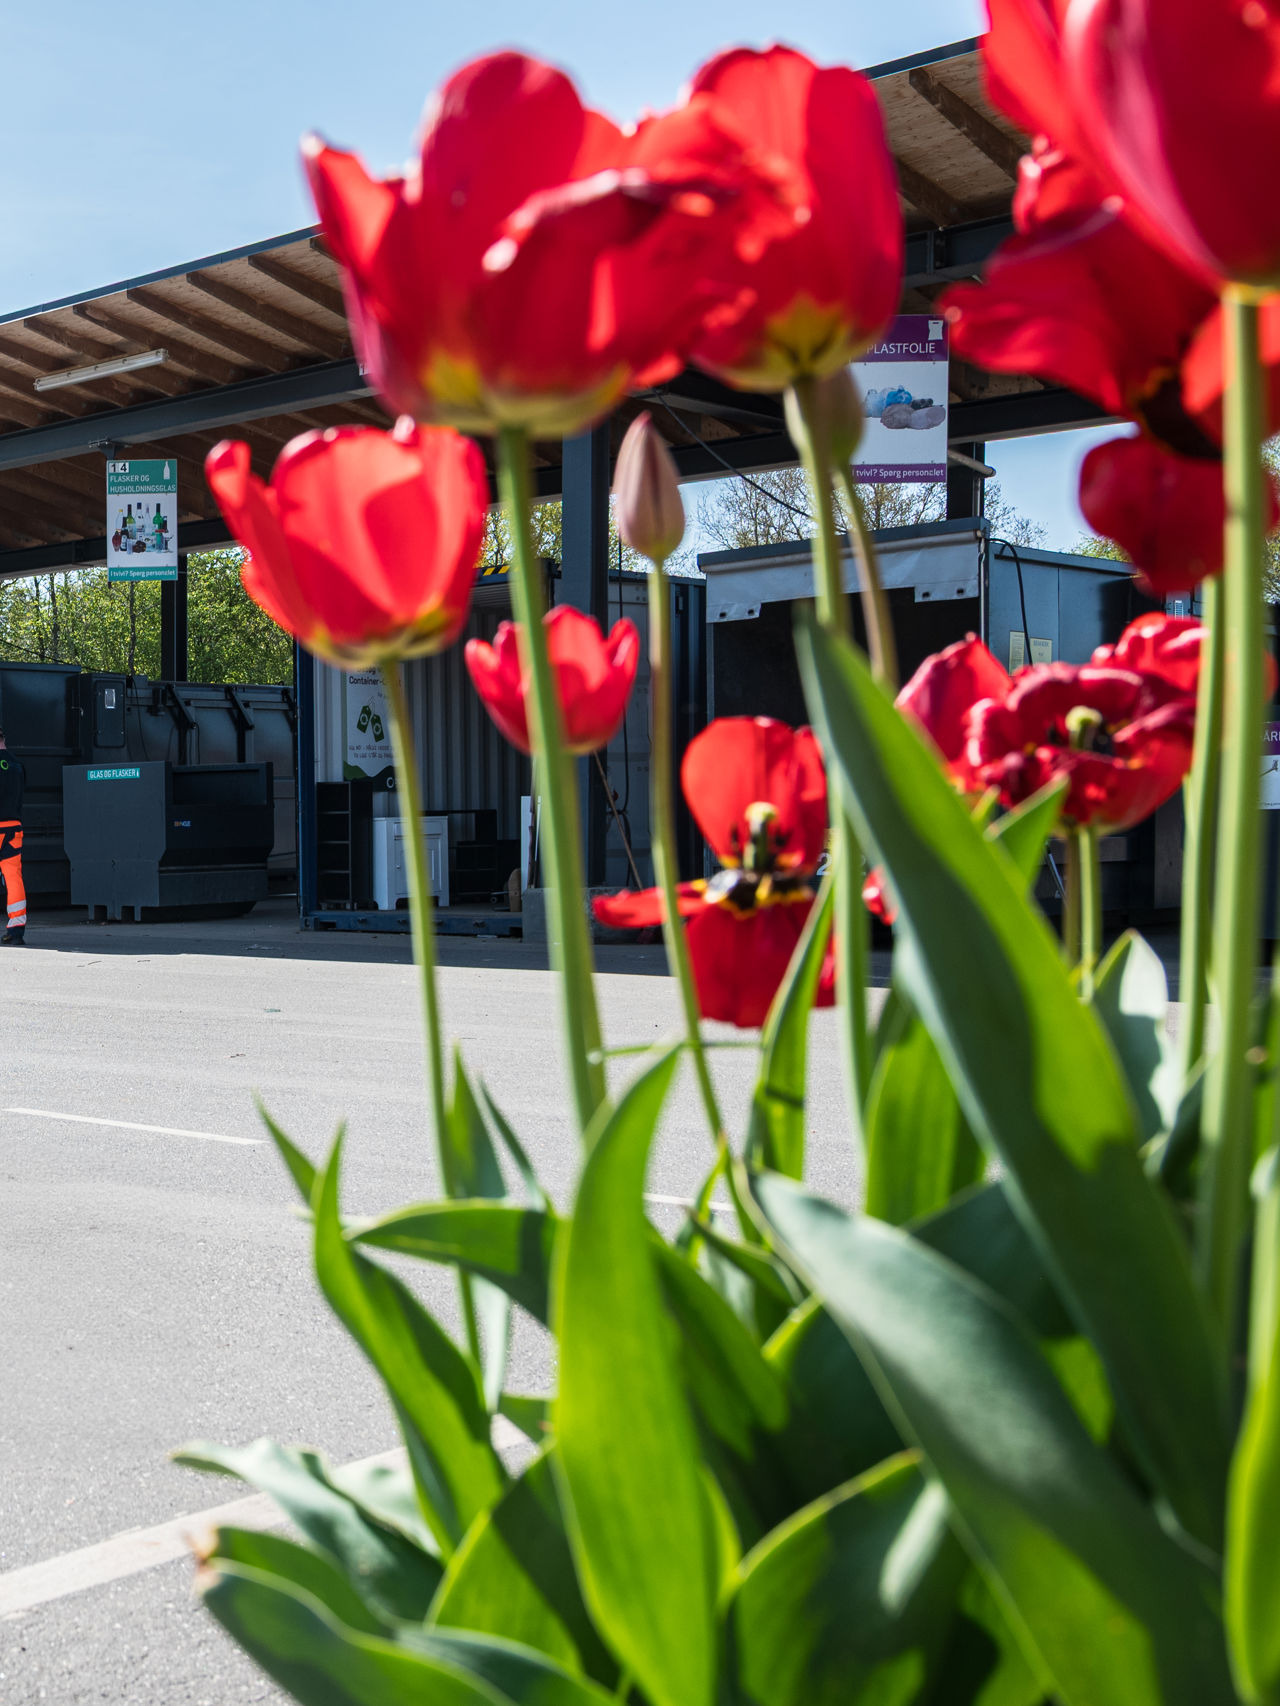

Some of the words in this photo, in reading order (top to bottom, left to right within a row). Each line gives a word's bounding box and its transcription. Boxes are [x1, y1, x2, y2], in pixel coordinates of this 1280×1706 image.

[867, 342, 936, 354] PLASTFOLIE
[111, 463, 127, 473] 14
[110, 484, 176, 493] HUSHOLDNINGSGLAS
[90, 770, 104, 779] GLAS
[104, 769, 112, 778] OG
[112, 768, 136, 778] FLASKER
